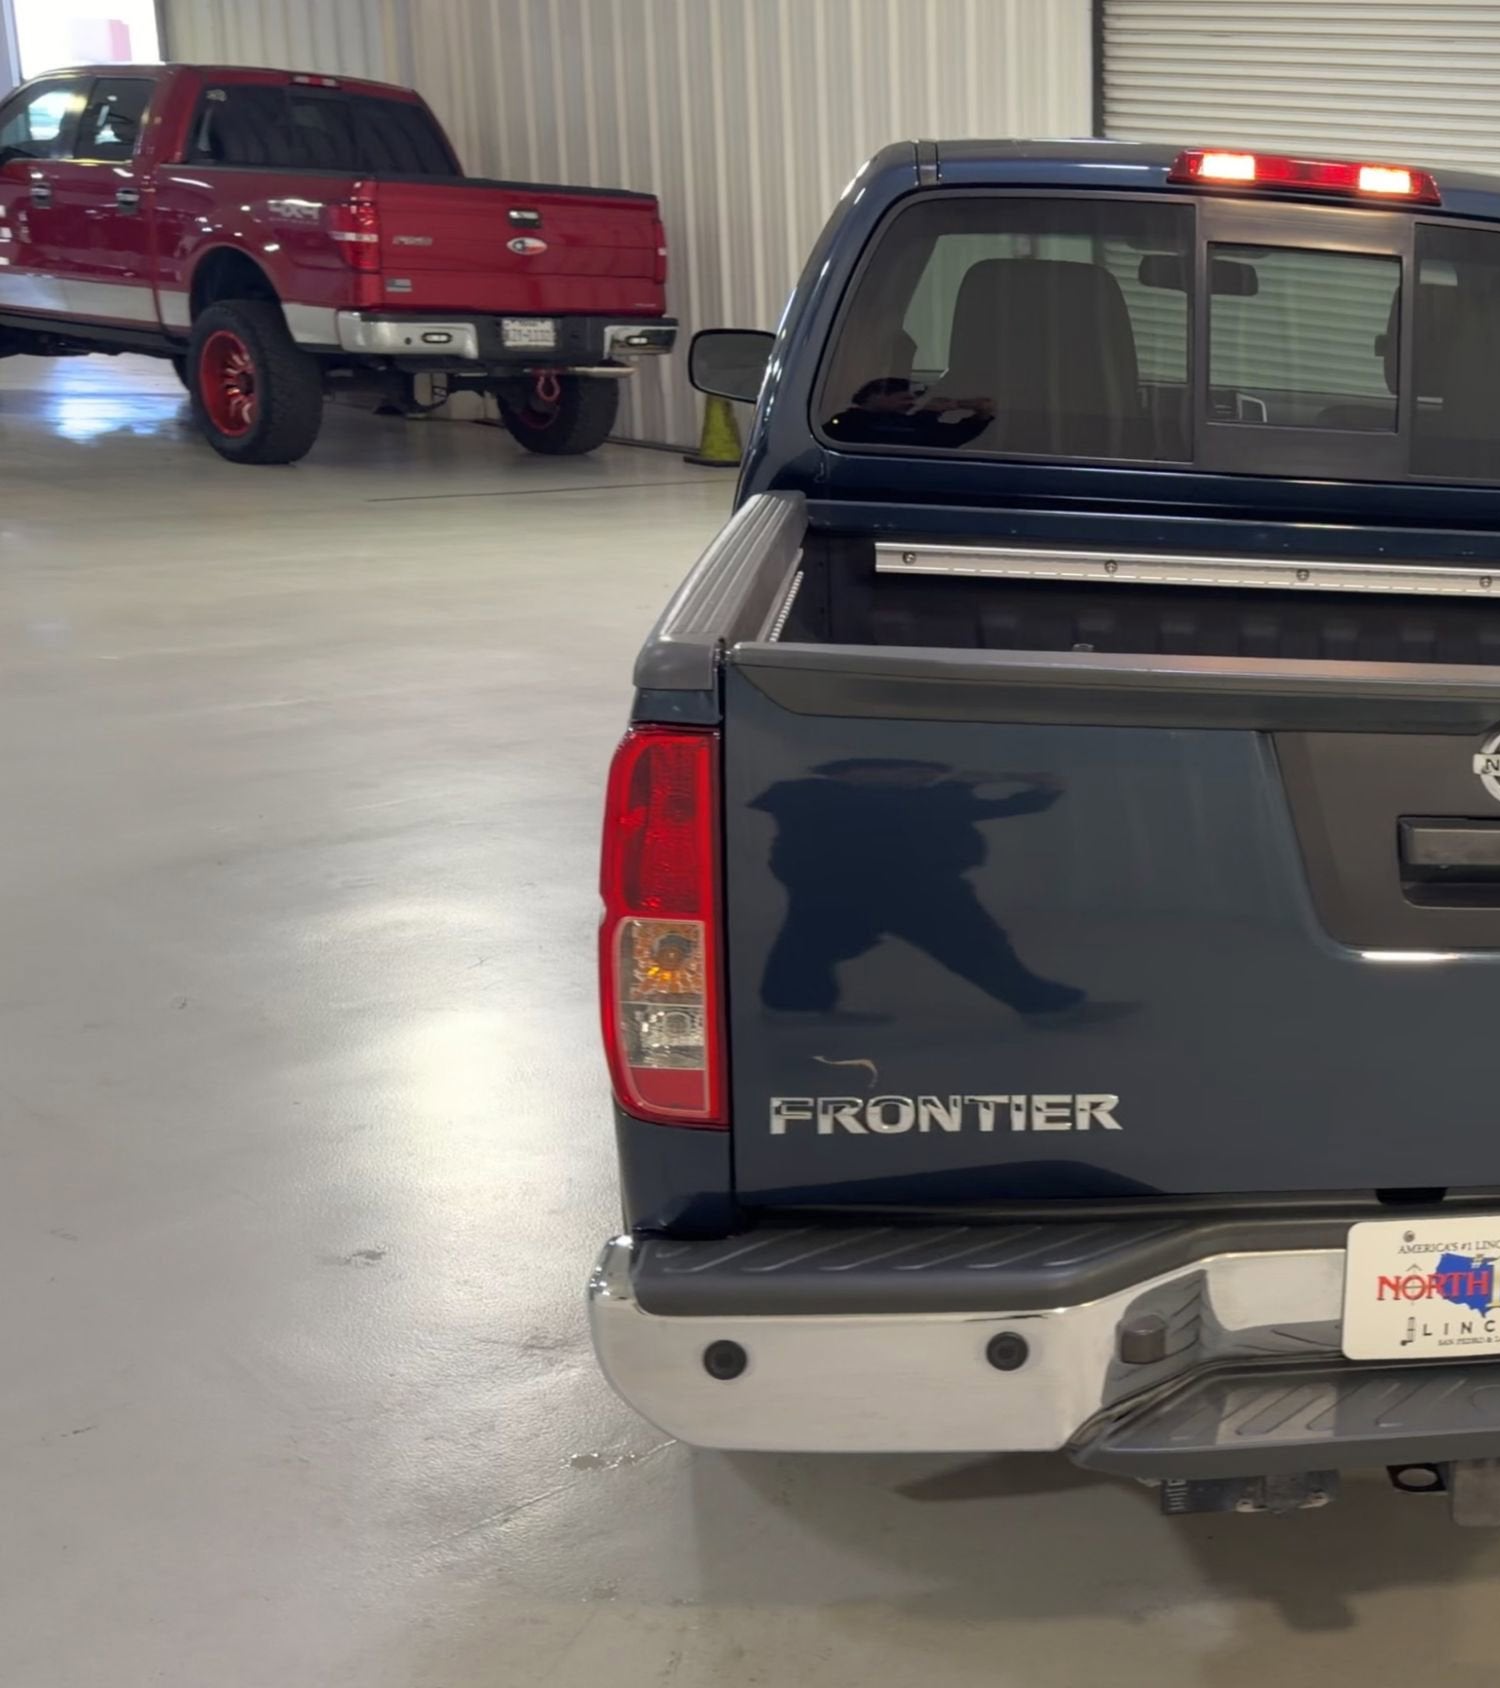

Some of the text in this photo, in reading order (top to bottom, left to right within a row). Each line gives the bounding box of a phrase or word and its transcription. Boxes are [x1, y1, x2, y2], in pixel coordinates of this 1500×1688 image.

[769, 1094, 1123, 1135] FRONTIER
[1398, 1240, 1459, 1254] AMERICA'S
[1376, 1270, 1488, 1301] NORTH
